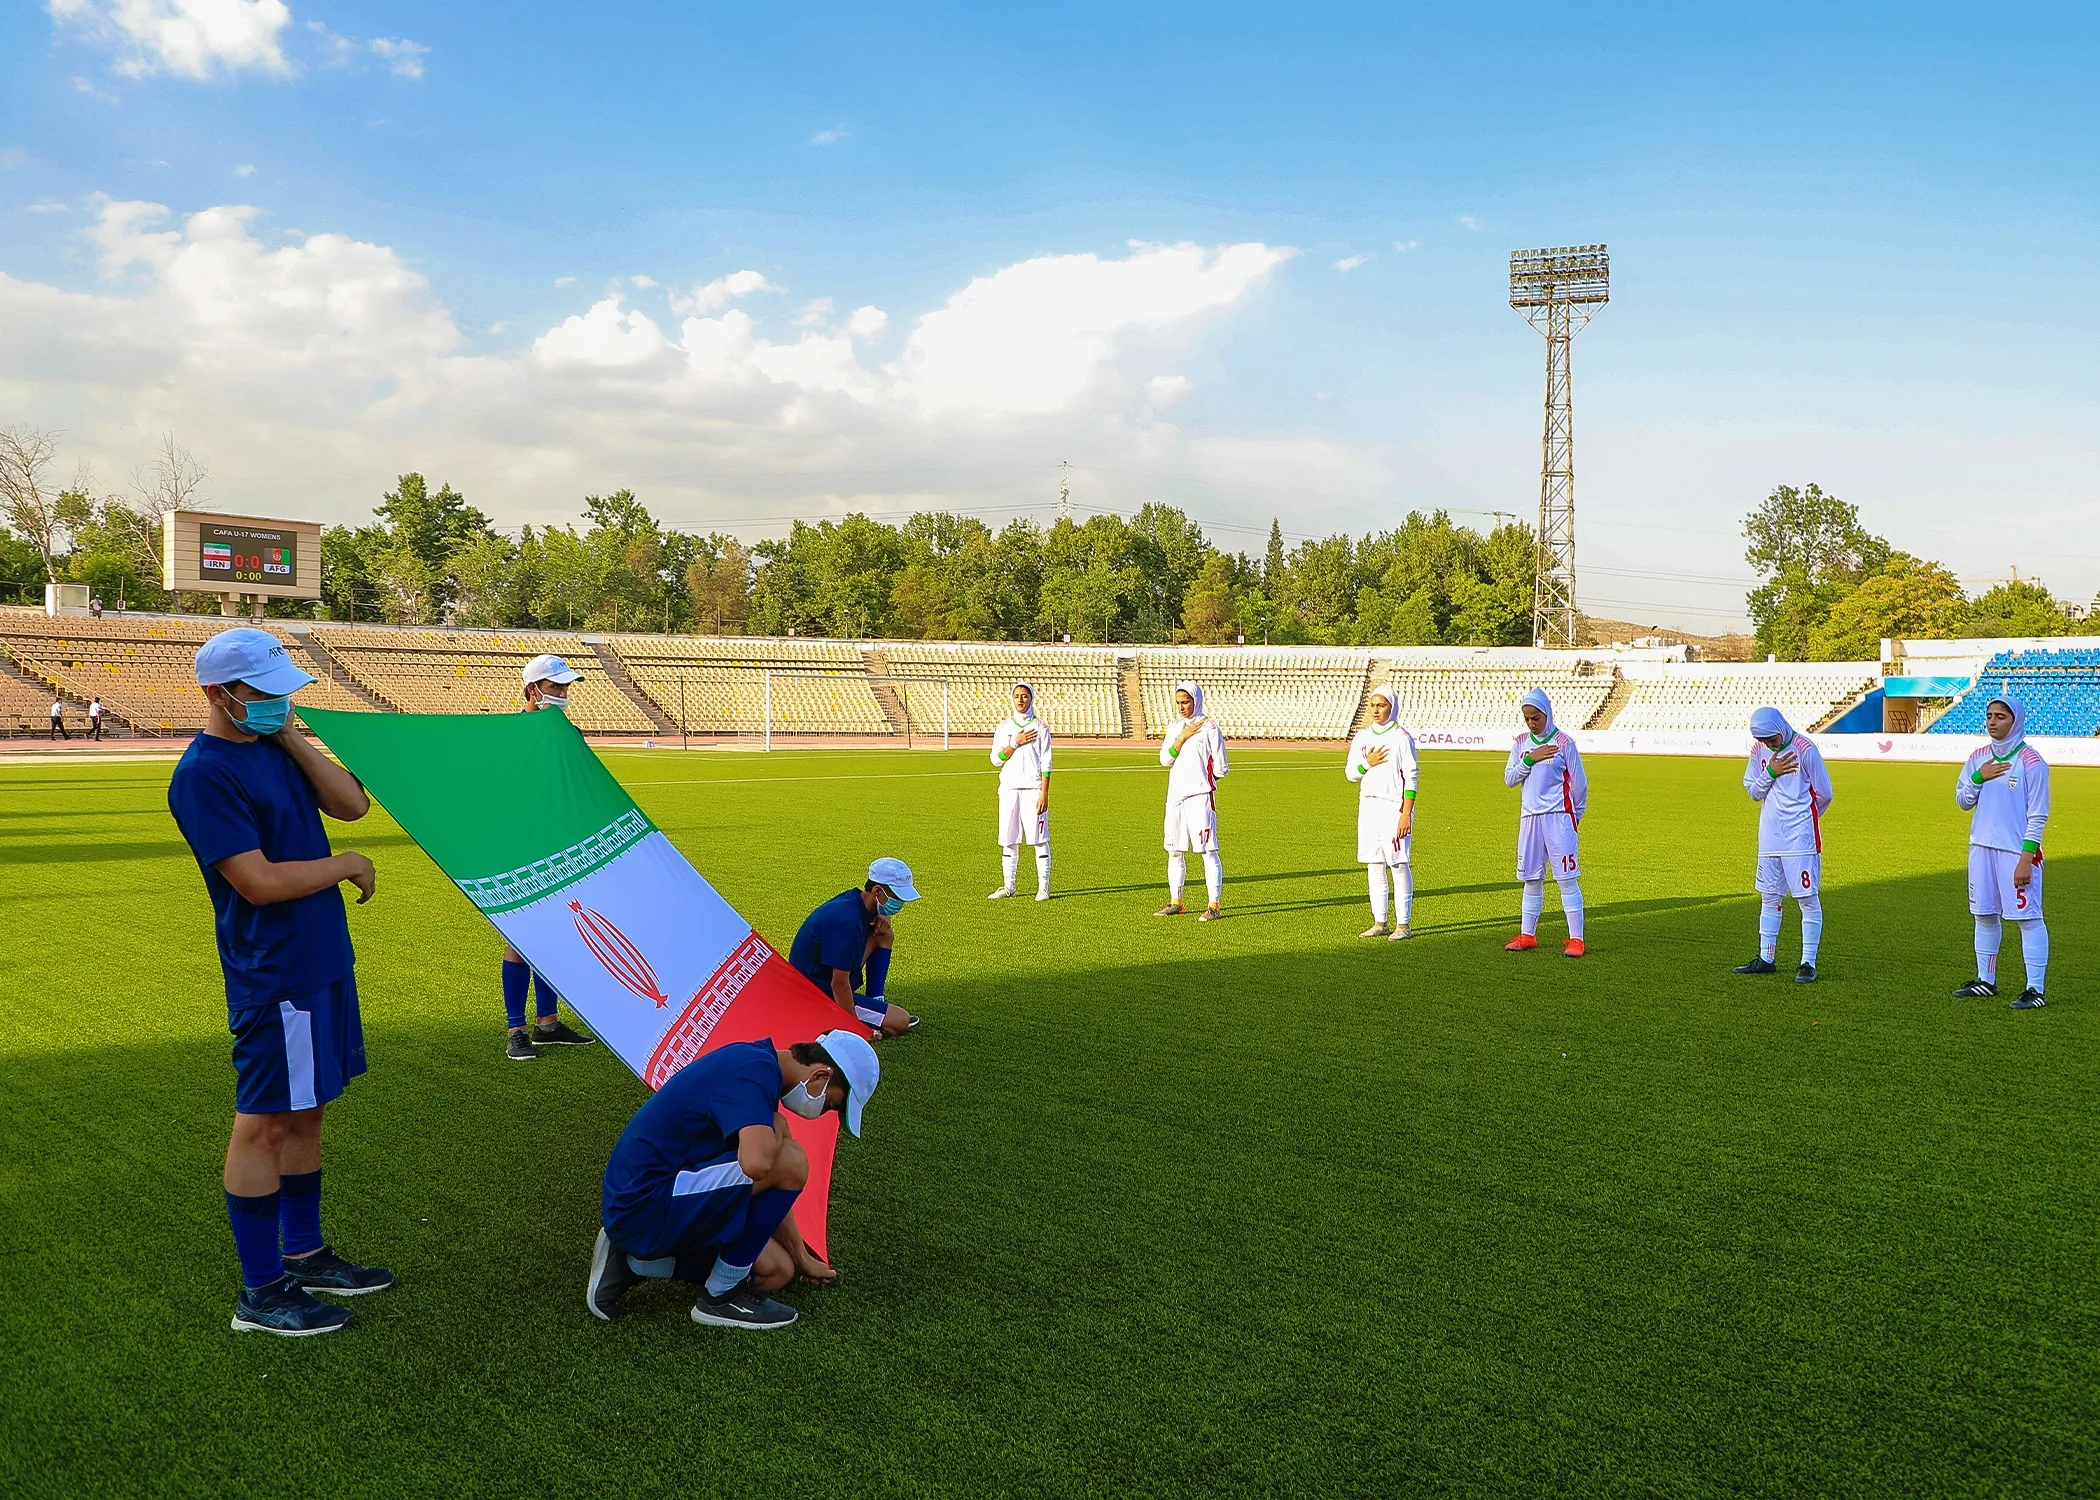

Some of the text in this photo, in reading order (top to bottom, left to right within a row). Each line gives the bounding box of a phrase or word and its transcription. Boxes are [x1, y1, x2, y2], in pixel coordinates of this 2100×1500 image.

[213, 529, 233, 537] CAFA
[250, 532, 281, 540] WOMENS
[209, 560, 226, 568] IRN
[269, 565, 286, 573] AFG
[1039, 820, 1045, 834] 7
[1199, 828, 1211, 844] 17
[1392, 836, 1401, 852] 11
[1562, 853, 1577, 872] 15
[1801, 870, 1810, 889] 8
[2016, 888, 2027, 910] 5
